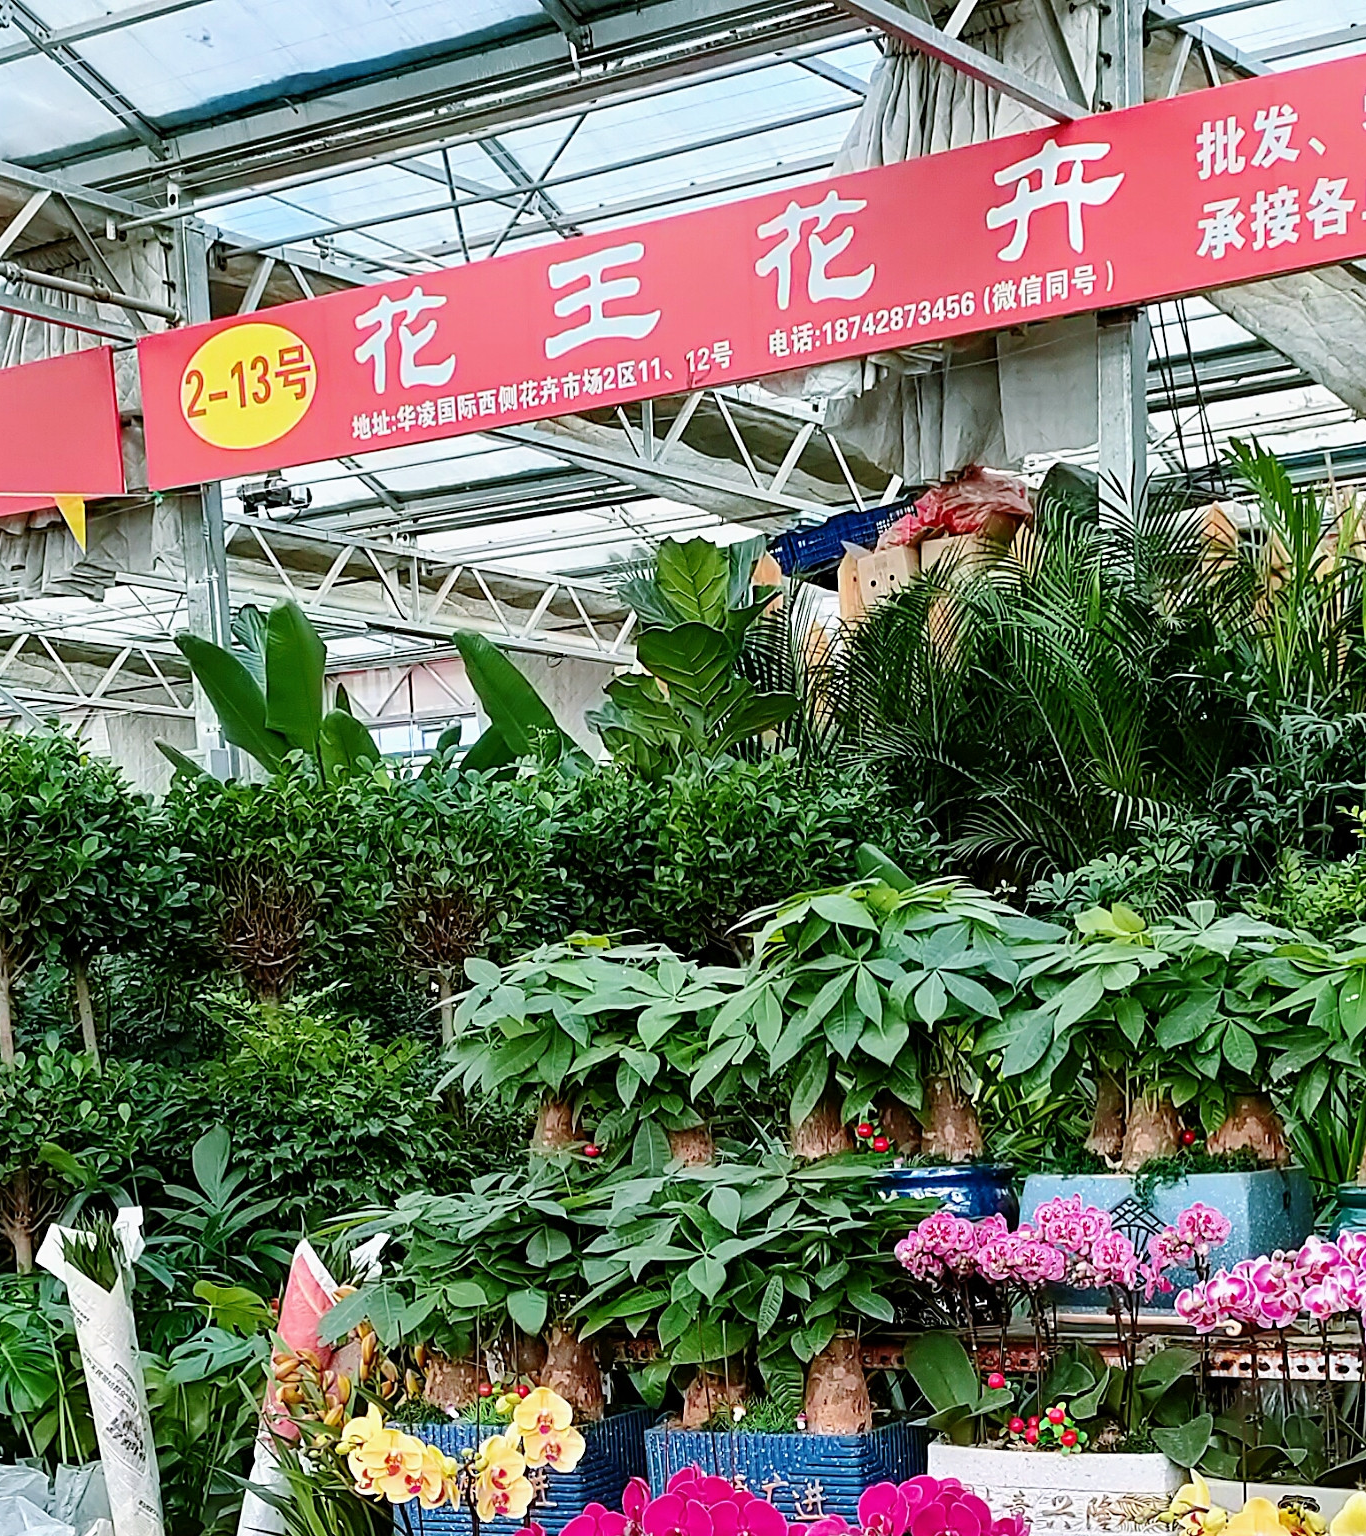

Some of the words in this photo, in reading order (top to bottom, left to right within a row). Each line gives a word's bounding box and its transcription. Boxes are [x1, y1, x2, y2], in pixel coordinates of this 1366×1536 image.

[354, 139, 1125, 394] 花王花卉
[768, 292, 975, 358] 电话:18742873456
[186, 343, 312, 419] 2-13号
[351, 340, 733, 440] 地址:华凌国际西侧花卉市场2区11、12号
